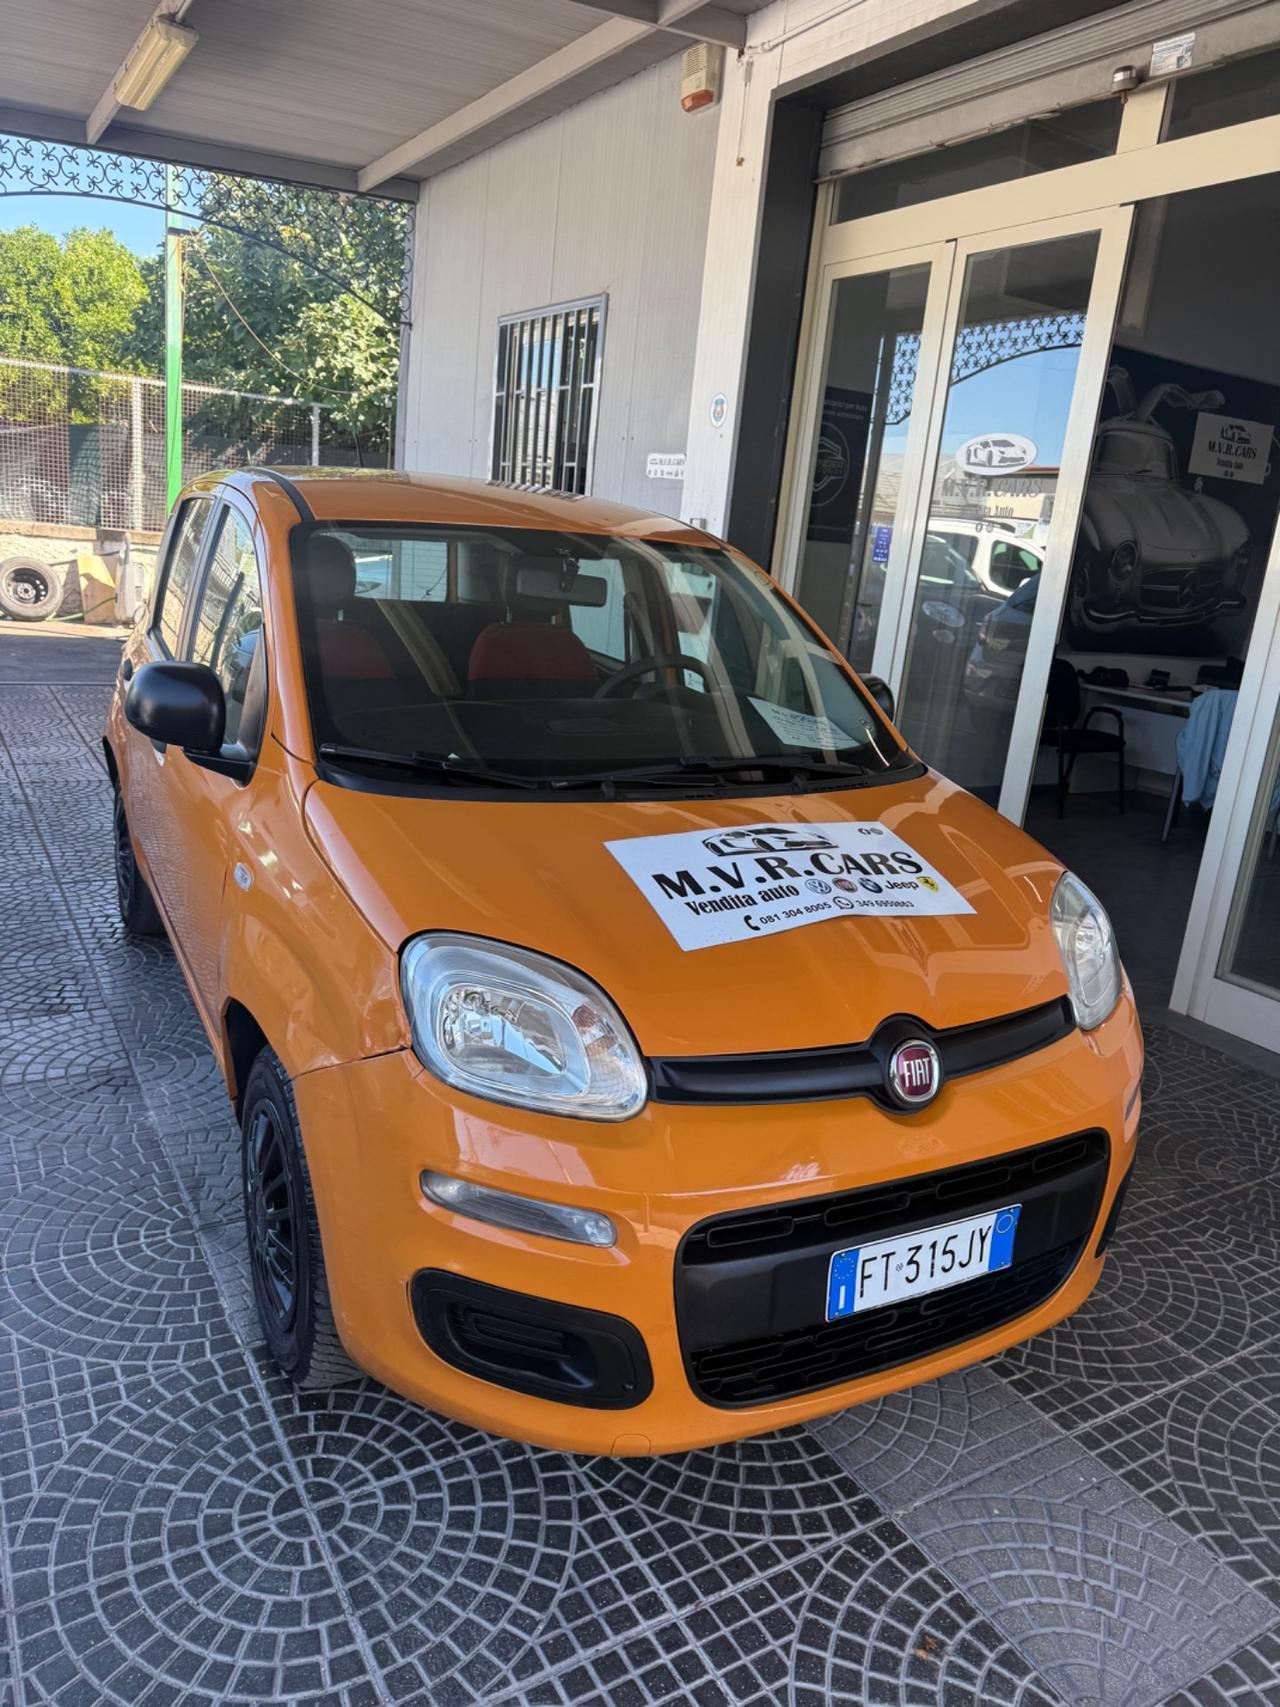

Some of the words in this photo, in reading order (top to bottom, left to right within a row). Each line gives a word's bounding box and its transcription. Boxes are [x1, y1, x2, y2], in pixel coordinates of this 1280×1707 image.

[652, 852, 923, 899] M.V.R.CARS
[884, 880, 919, 893] Jeep
[684, 893, 757, 916] Vendita
[757, 884, 800, 903] auto
[759, 914, 782, 925] 081
[782, 906, 804, 919] 304
[804, 901, 832, 913] 8005
[903, 1056, 930, 1088] FIAT
